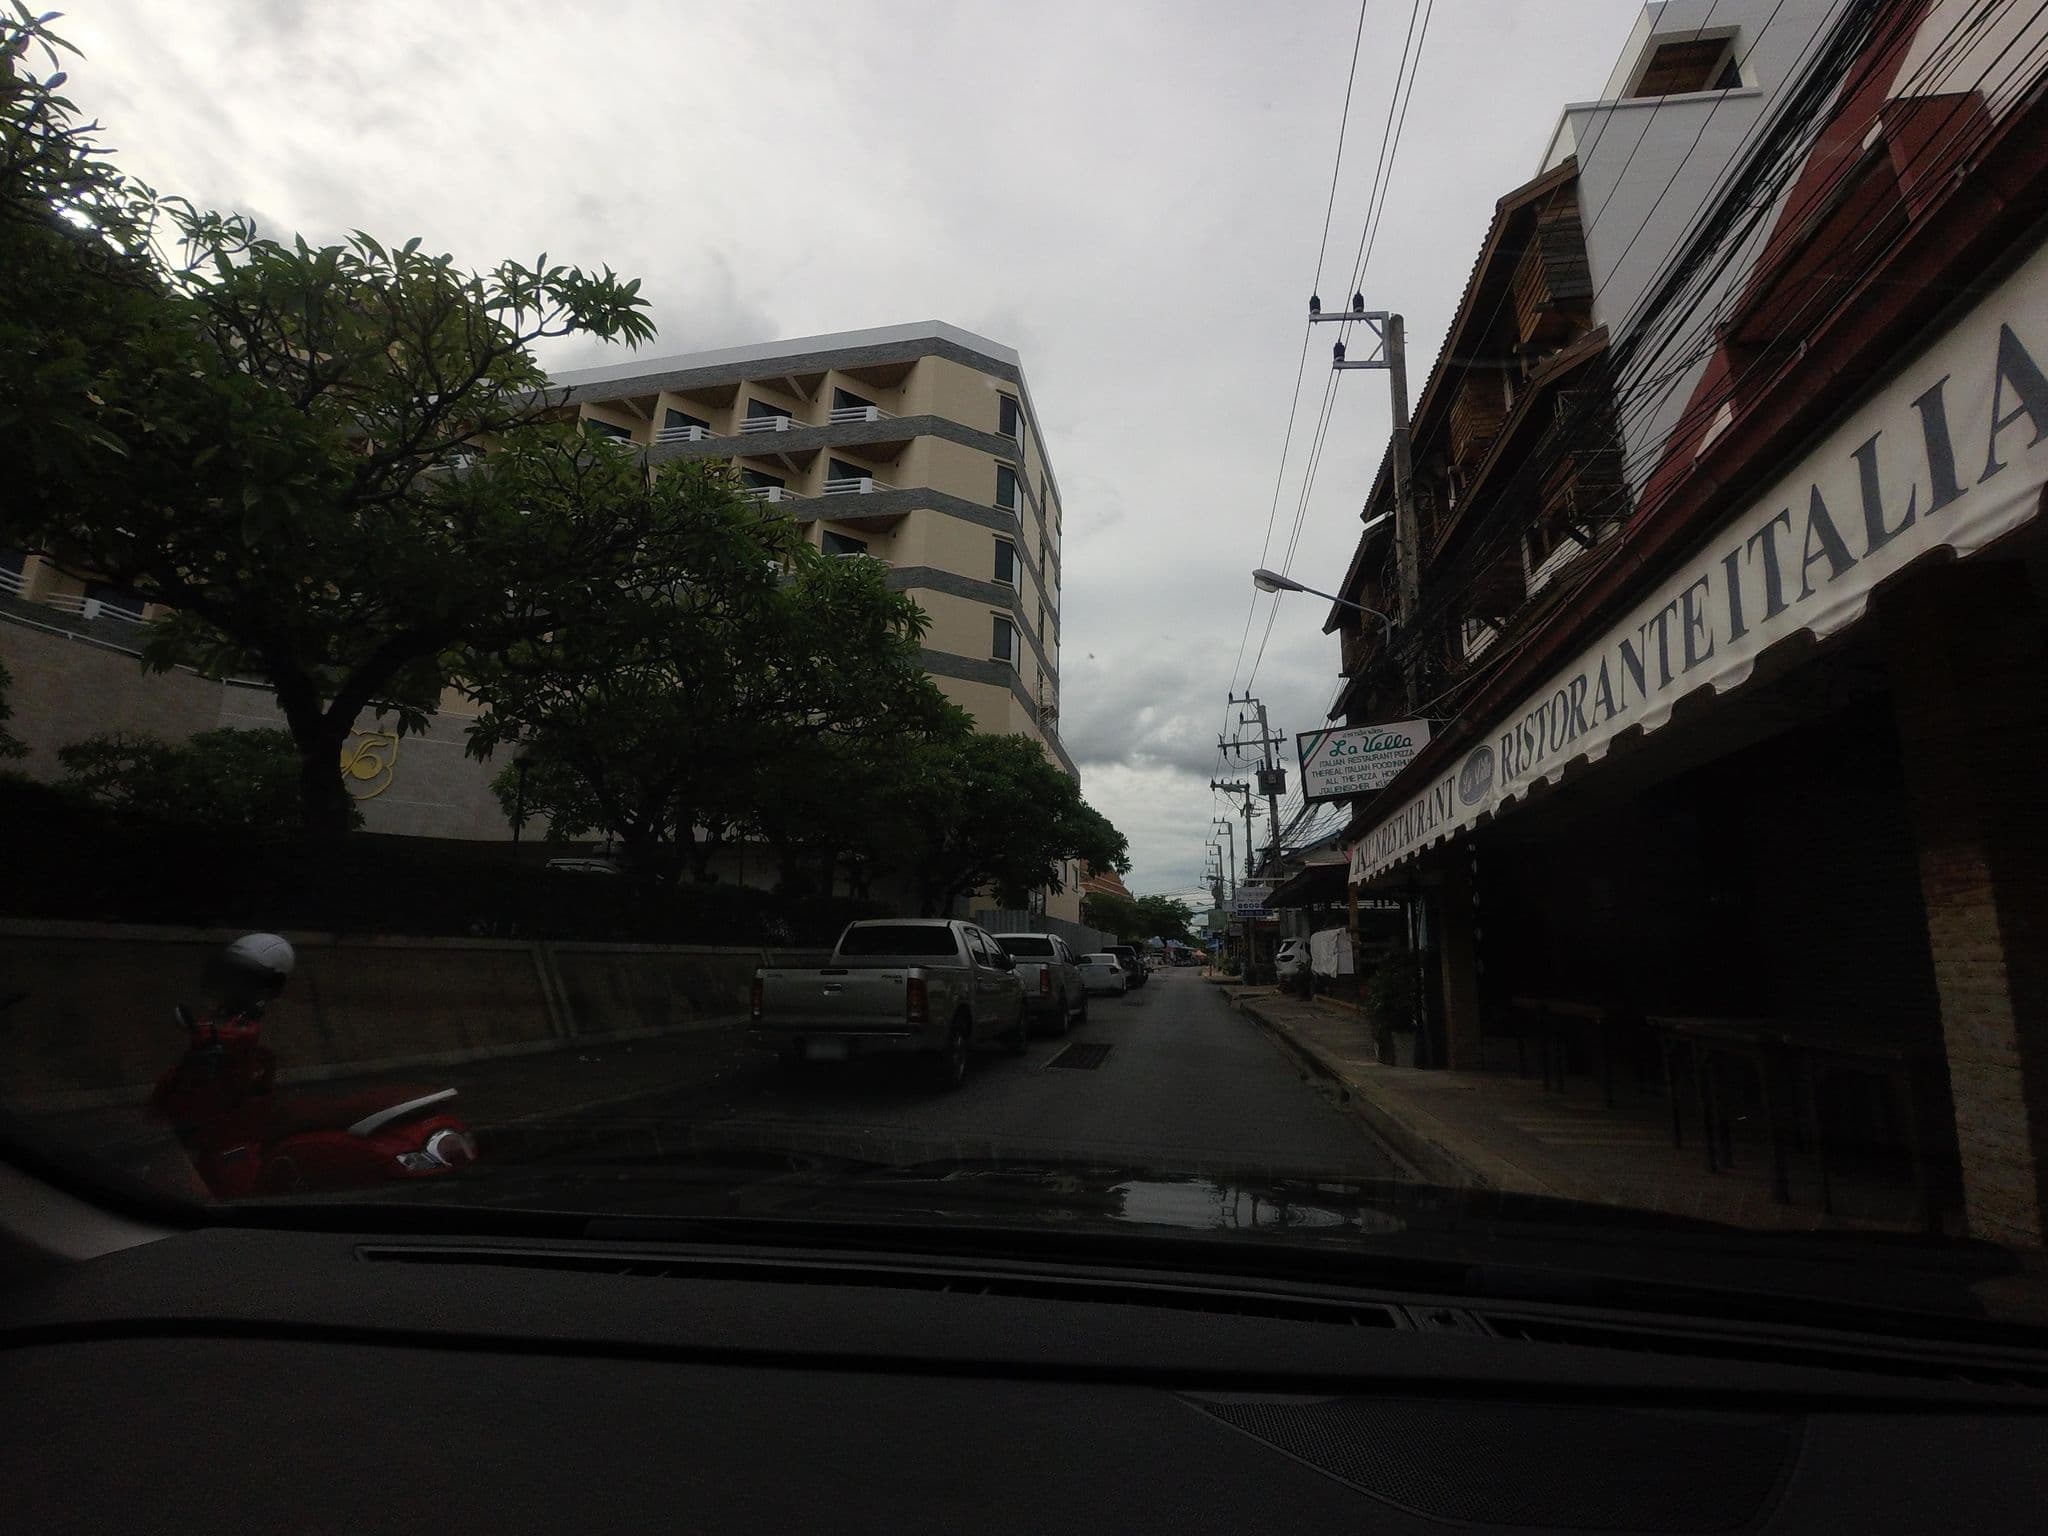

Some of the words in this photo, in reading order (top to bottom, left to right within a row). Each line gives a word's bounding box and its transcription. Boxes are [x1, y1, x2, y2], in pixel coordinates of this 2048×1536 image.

[1501, 574, 1714, 787] RISTORANTE
[1329, 740, 1358, 757] La
[1362, 732, 1413, 752] Vella
[1319, 758, 1346, 768] ITALIAN
[1348, 753, 1394, 764] RESTAURANT
[1394, 749, 1415, 759] PIZZA
[1345, 763, 1371, 774] ITALIAN
[1342, 774, 1356, 783] THE
[1357, 771, 1377, 781] PIZZA
[1382, 776, 1455, 859] RESTAURANT
